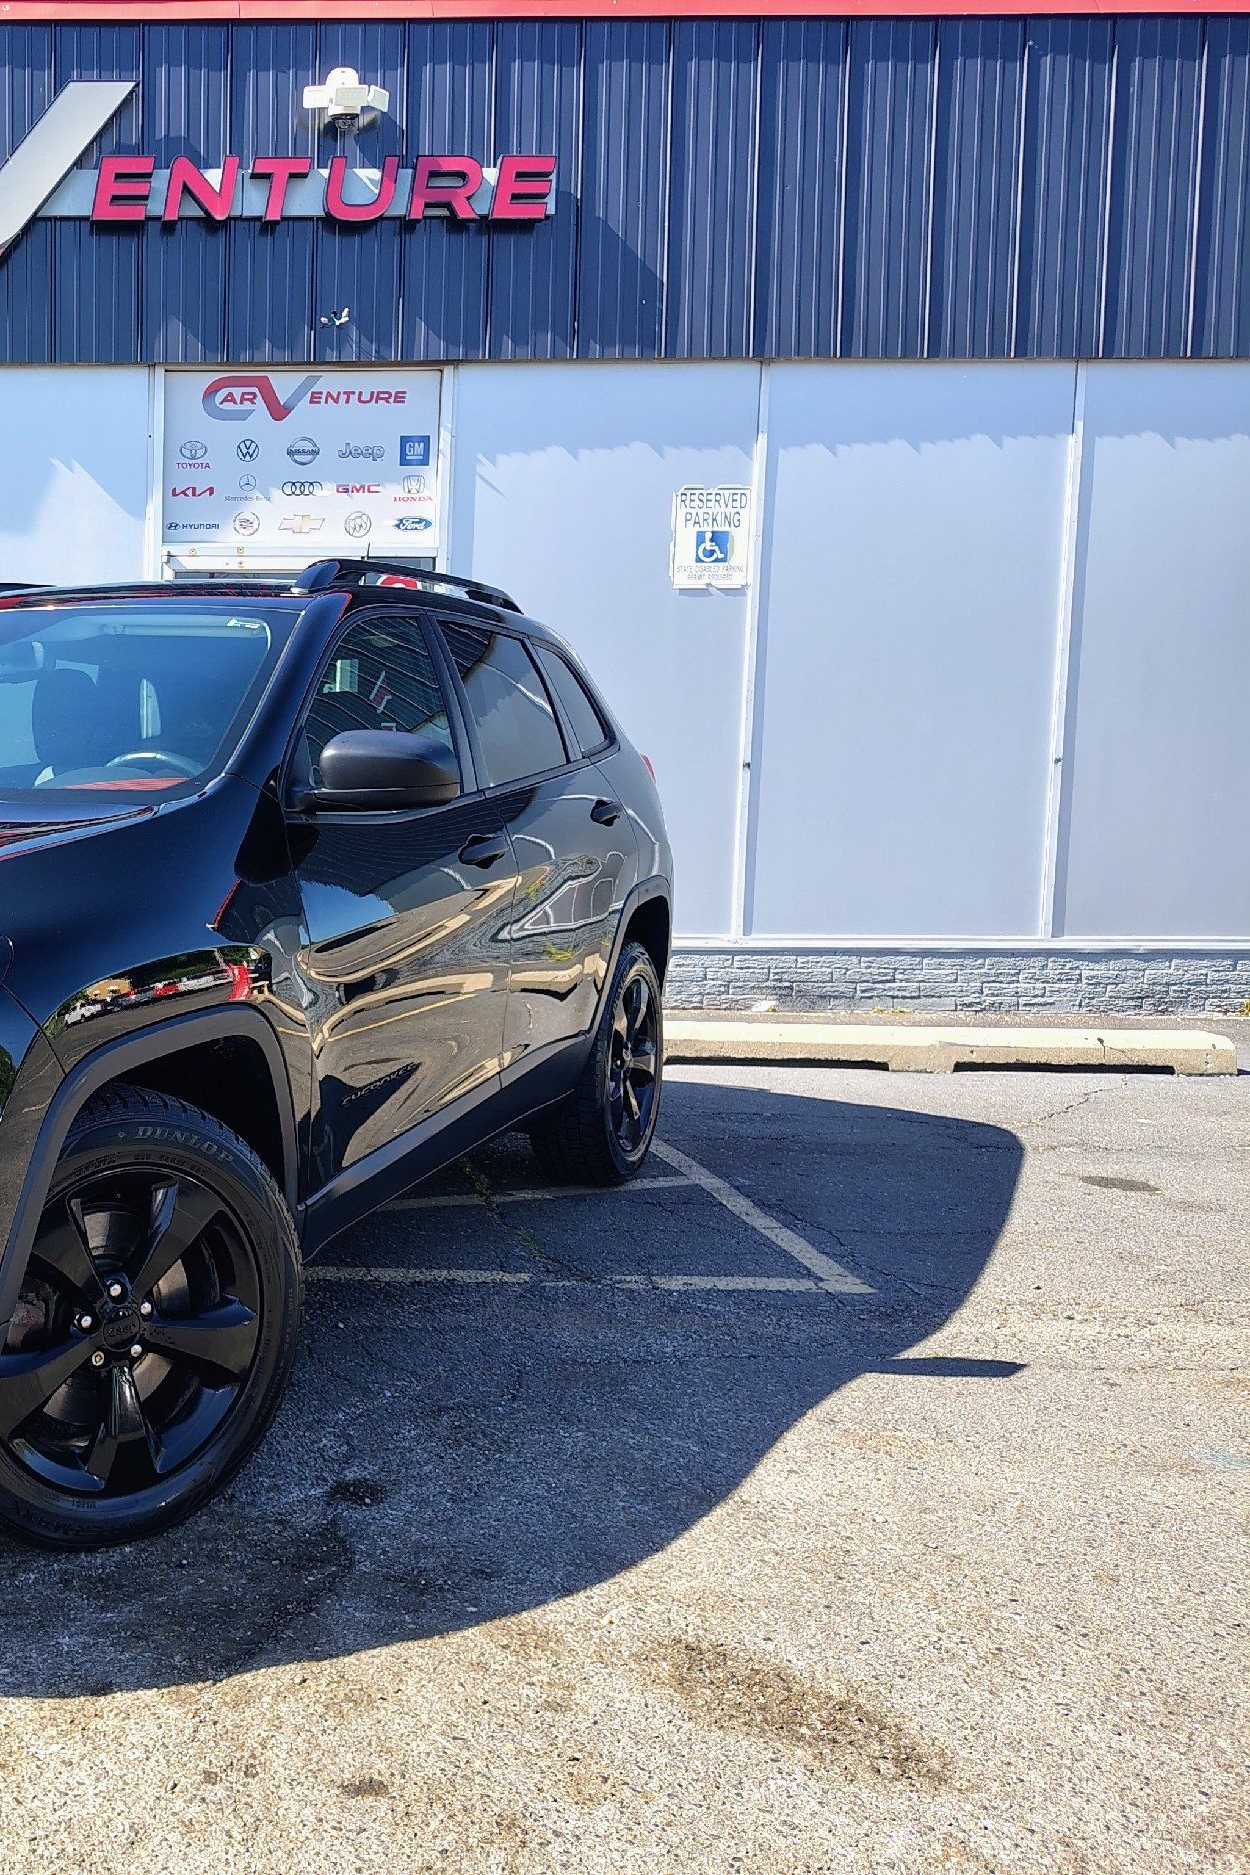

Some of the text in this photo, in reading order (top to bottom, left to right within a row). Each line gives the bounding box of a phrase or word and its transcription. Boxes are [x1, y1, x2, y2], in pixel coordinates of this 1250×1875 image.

[338, 443, 385, 461] Jeep
[405, 442, 424, 456] GM
[171, 486, 215, 497] KIA
[336, 483, 381, 493] GMC
[680, 492, 747, 509] RESERVED
[399, 518, 426, 530] Ford
[685, 511, 741, 528] PARKING
[134, 1126, 234, 1163] DUNLOP
